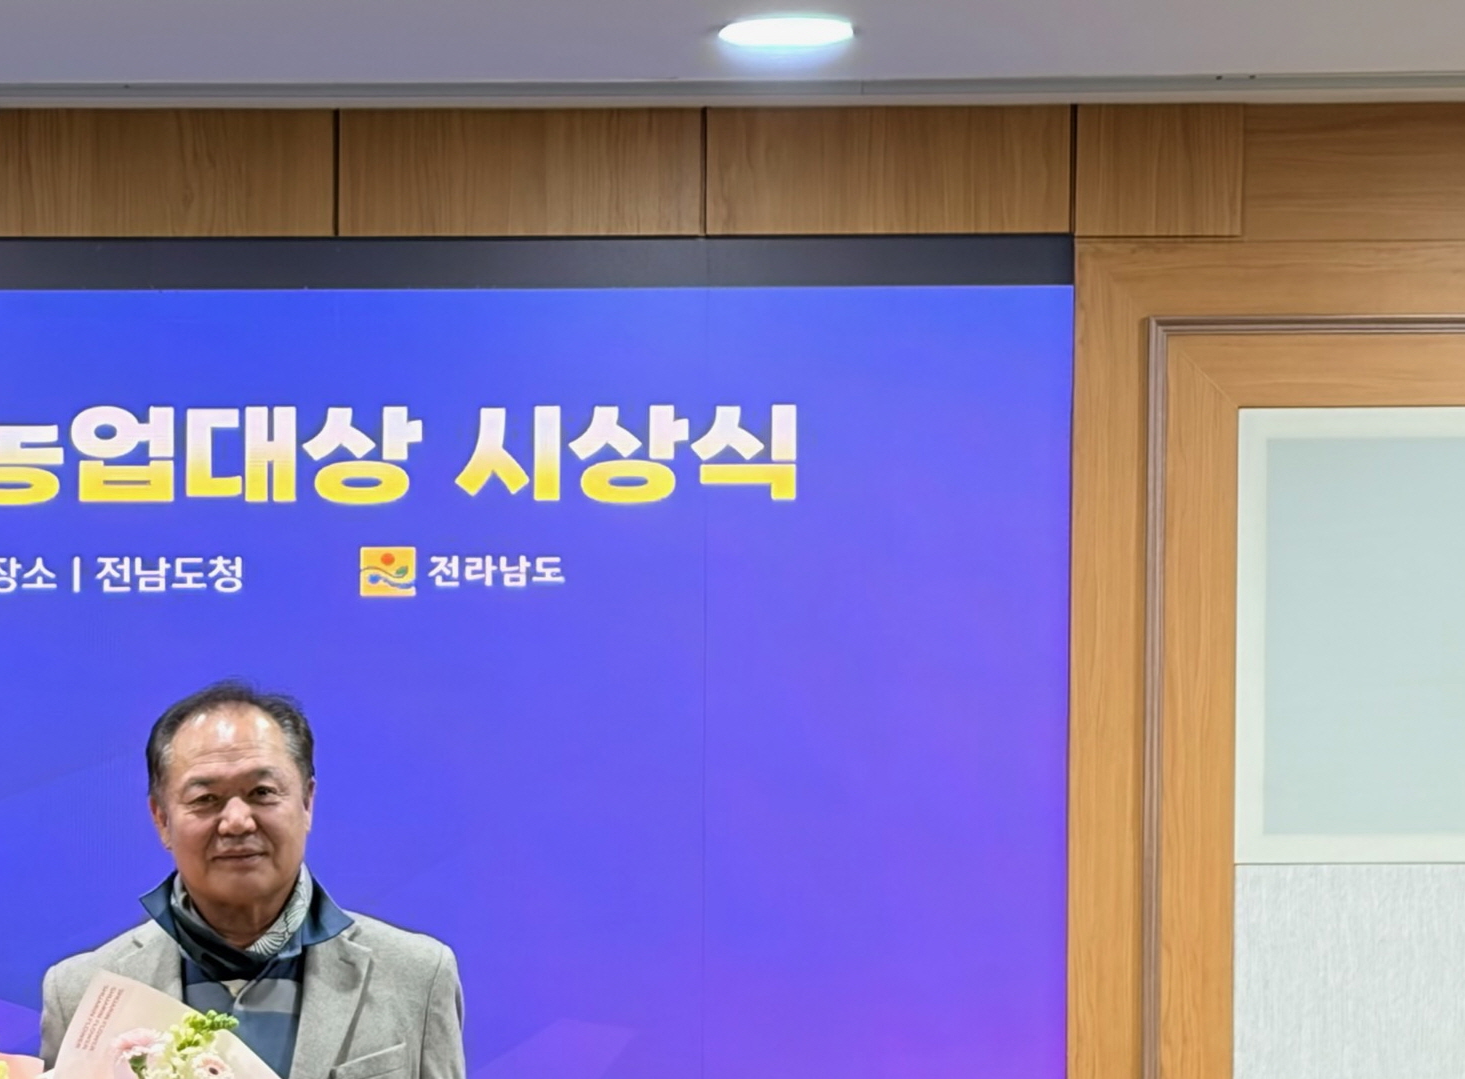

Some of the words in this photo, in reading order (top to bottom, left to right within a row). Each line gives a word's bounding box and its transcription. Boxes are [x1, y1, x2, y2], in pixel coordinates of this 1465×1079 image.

[454, 403, 798, 506] 시상식
[95, 555, 243, 594] 전남도청
[427, 554, 567, 589] 전라남도
